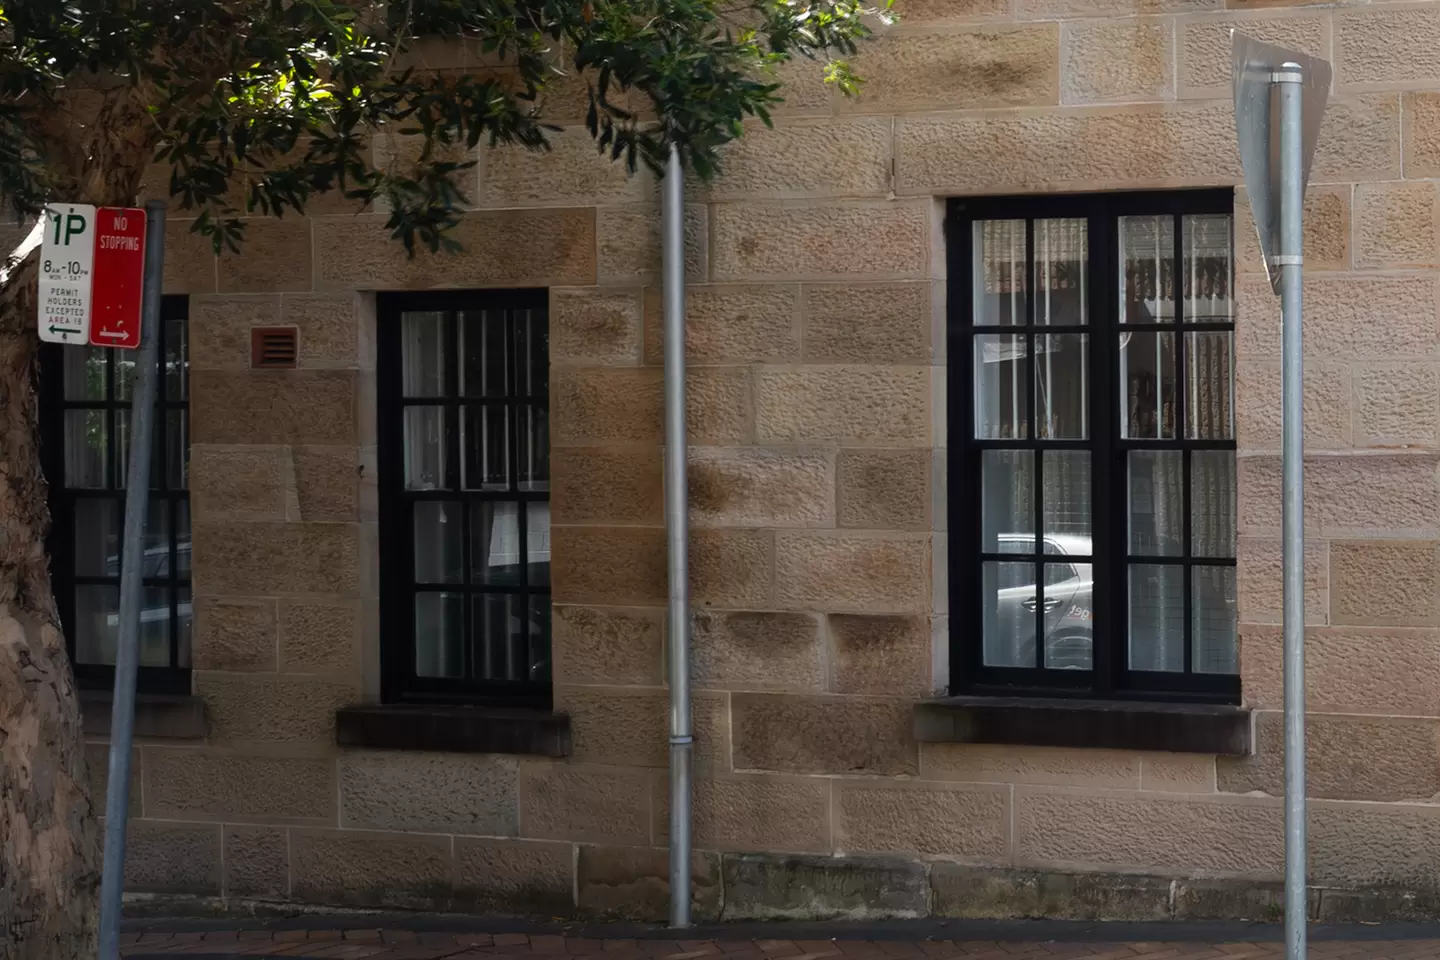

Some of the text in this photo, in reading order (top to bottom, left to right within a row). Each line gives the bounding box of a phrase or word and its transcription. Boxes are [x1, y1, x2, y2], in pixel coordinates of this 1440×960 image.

[113, 217, 128, 231] NO
[53, 214, 86, 246] 1P
[100, 235, 139, 251] STOPPING
[50, 287, 78, 297] PERMIT
[47, 297, 82, 307] HOLDERS
[45, 306, 85, 317] EXCEPTED
[48, 316, 70, 325] AREA
